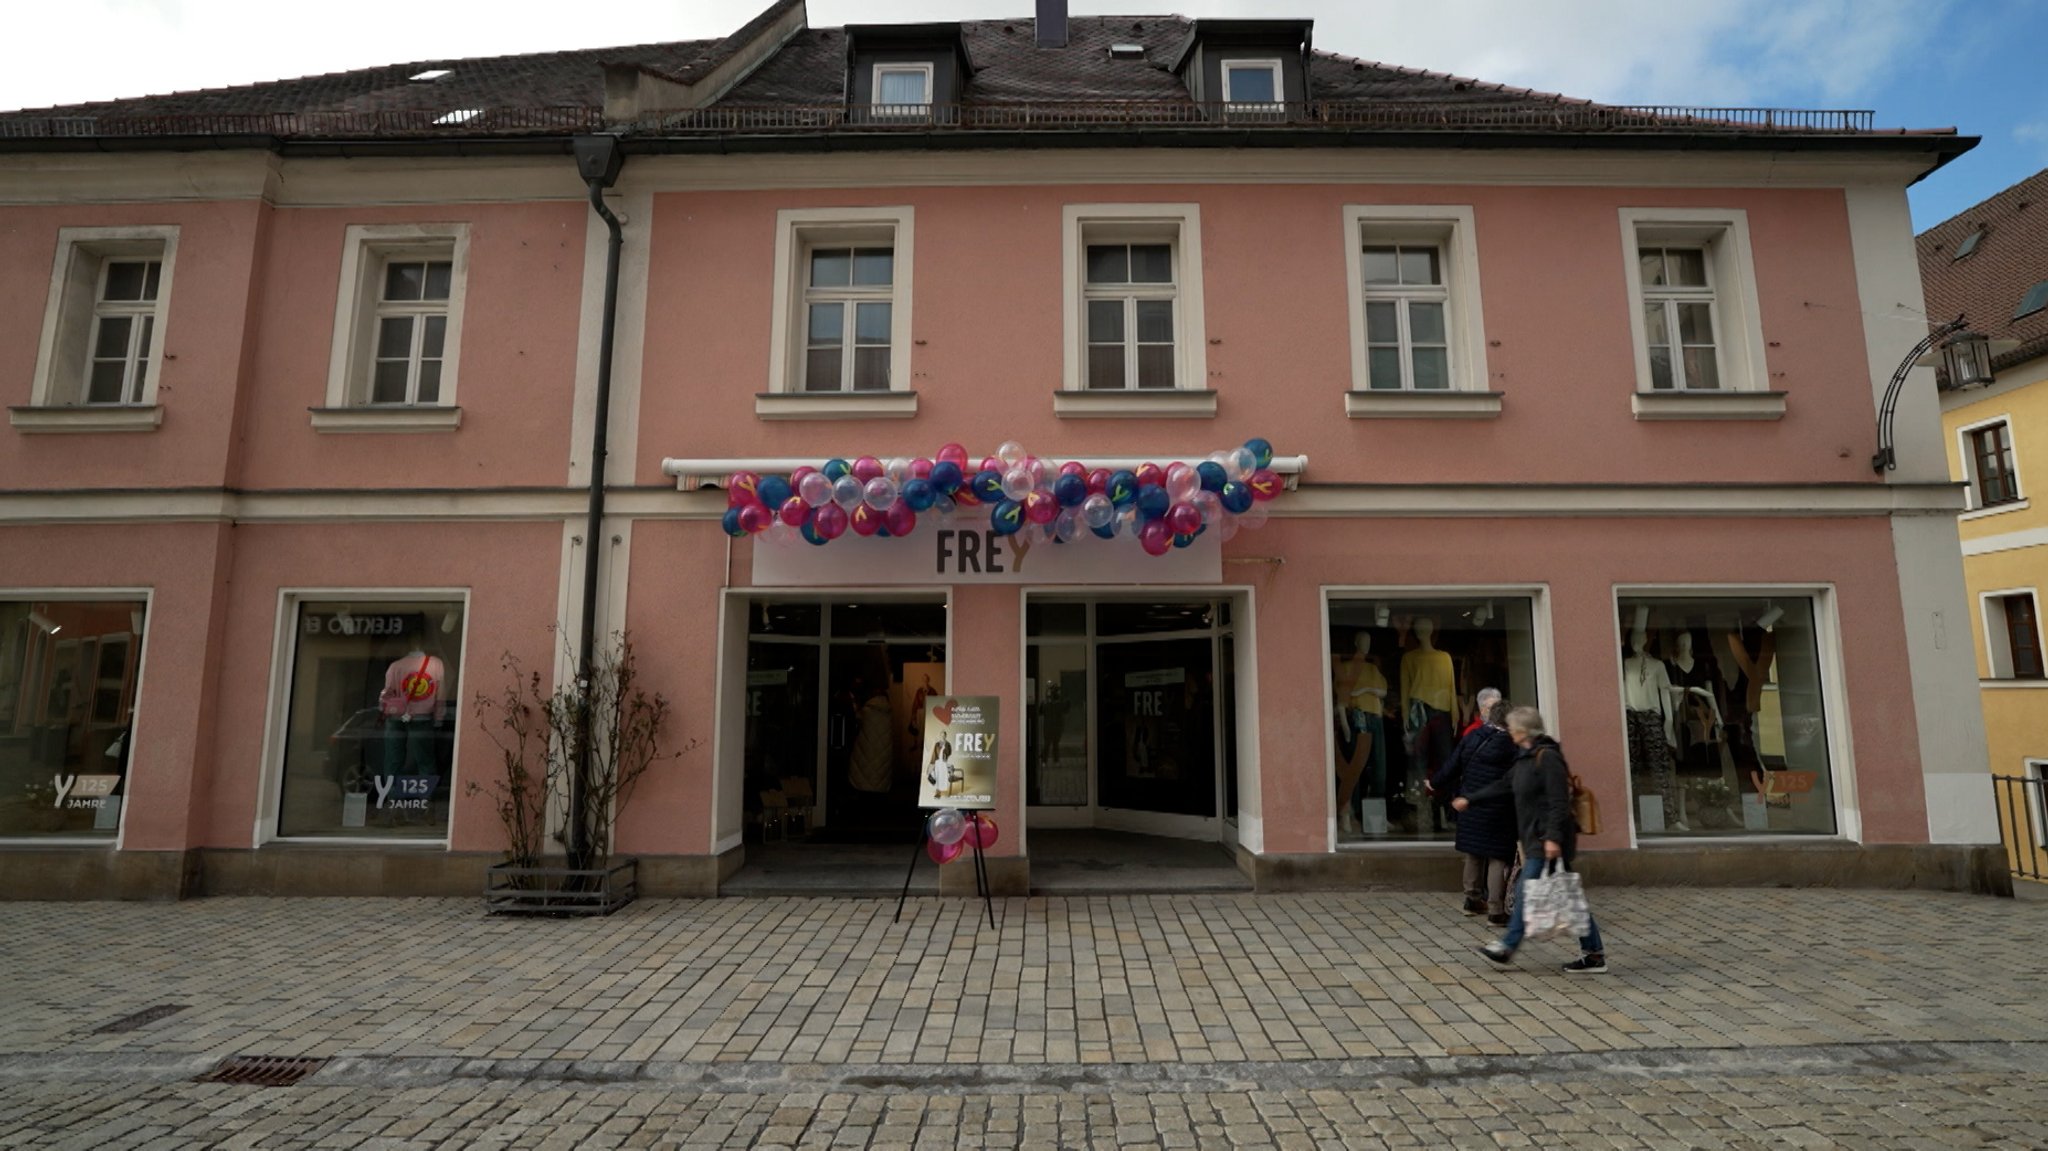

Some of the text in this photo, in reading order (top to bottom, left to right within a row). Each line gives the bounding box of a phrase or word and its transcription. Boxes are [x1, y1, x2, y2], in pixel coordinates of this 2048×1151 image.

[937, 529, 1032, 573] FREY
[955, 732, 996, 752] FREY
[54, 774, 108, 808] Y 125
[1780, 775, 1807, 788] 125
[374, 775, 429, 809] Y 125
[66, 799, 107, 809] JAHRE
[388, 799, 429, 809] JAHRE
